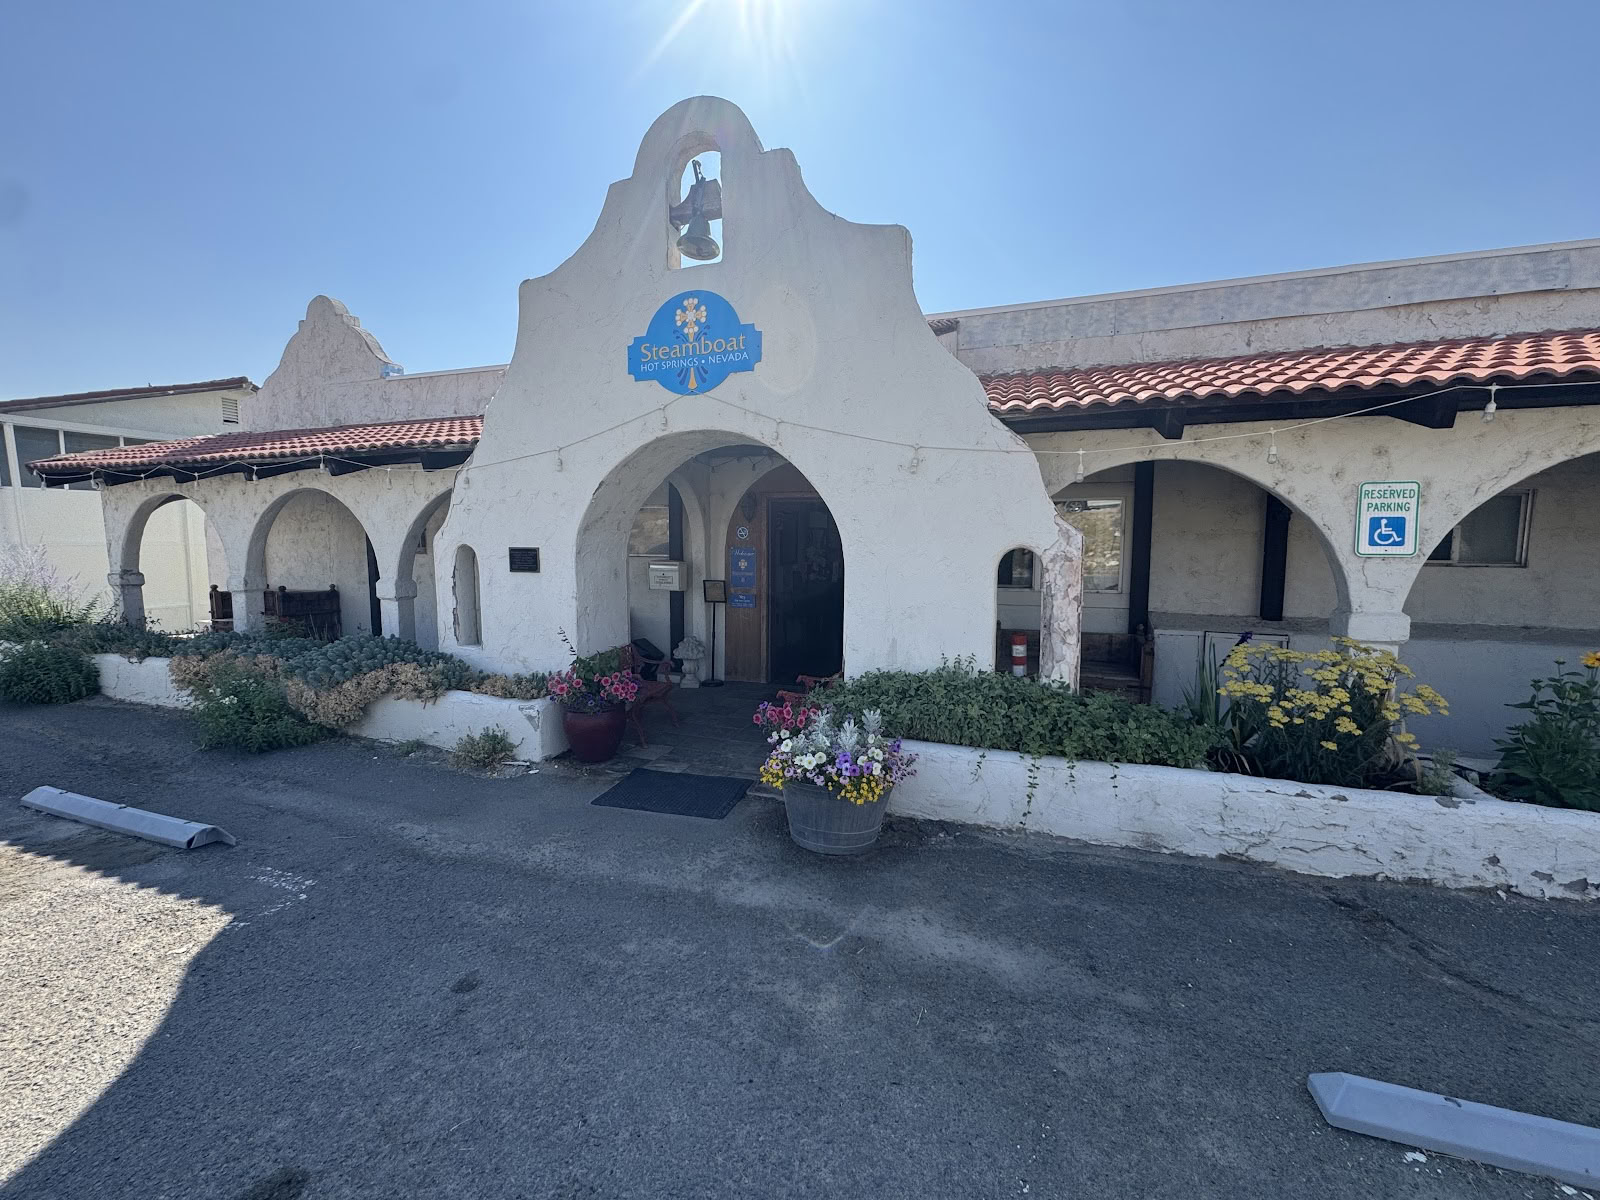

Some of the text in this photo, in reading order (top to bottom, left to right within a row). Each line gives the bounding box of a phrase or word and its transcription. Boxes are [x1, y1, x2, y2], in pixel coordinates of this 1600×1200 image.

[641, 333, 746, 362] Steamboat
[641, 352, 749, 372] HOT SPRINGS NEVADA
[1363, 489, 1416, 499] RESERVED
[1367, 502, 1411, 512] PARKING
